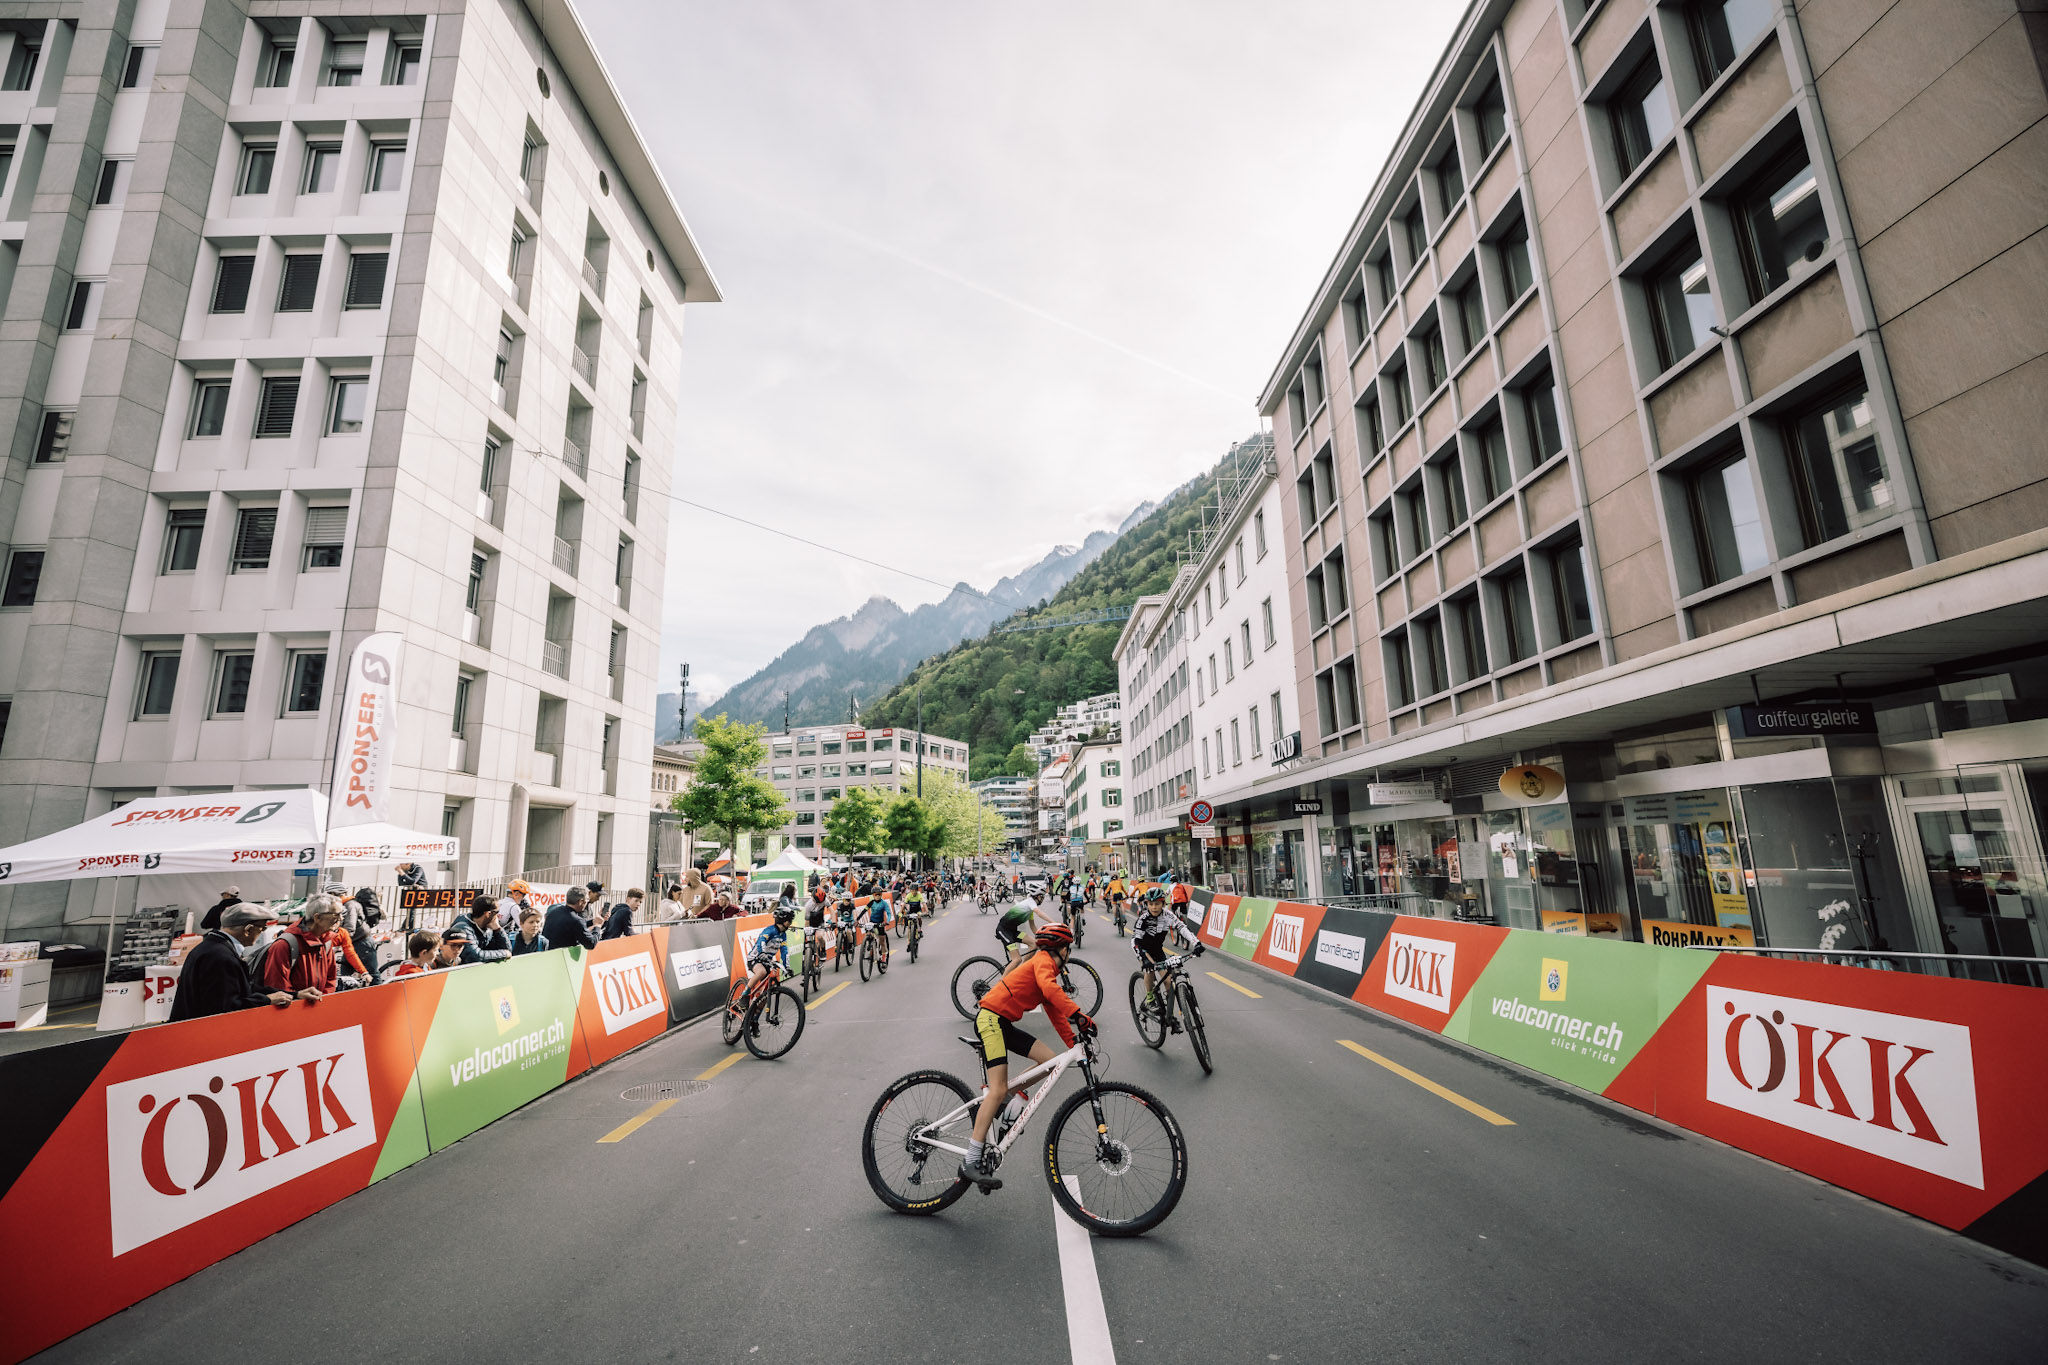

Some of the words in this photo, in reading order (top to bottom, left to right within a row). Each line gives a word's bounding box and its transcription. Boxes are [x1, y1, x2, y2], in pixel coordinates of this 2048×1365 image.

[346, 692, 379, 810] SPONSER
[1270, 735, 1295, 763] KIND
[111, 806, 242, 827] SPONSER
[1294, 803, 1321, 812] KIND
[78, 854, 140, 870] SPONSER
[231, 850, 294, 863] SPONSER
[1273, 918, 1299, 954] ÖKK
[1392, 939, 1447, 998] ÖKK
[598, 964, 658, 1018] ÖKK
[1491, 997, 1624, 1052] velocorner.ch
[450, 1017, 565, 1087] velocorner.ch
[520, 1055, 541, 1071] click
[543, 1044, 566, 1061] n'ride
[1550, 1037, 1577, 1053] click
[1581, 1047, 1617, 1065] n'ride
[1724, 1001, 1948, 1146] ÖKK
[138, 1053, 357, 1196] ÖKK
[1048, 1144, 1060, 1184] MAXXIS
[907, 1198, 942, 1209] MAXXIS
